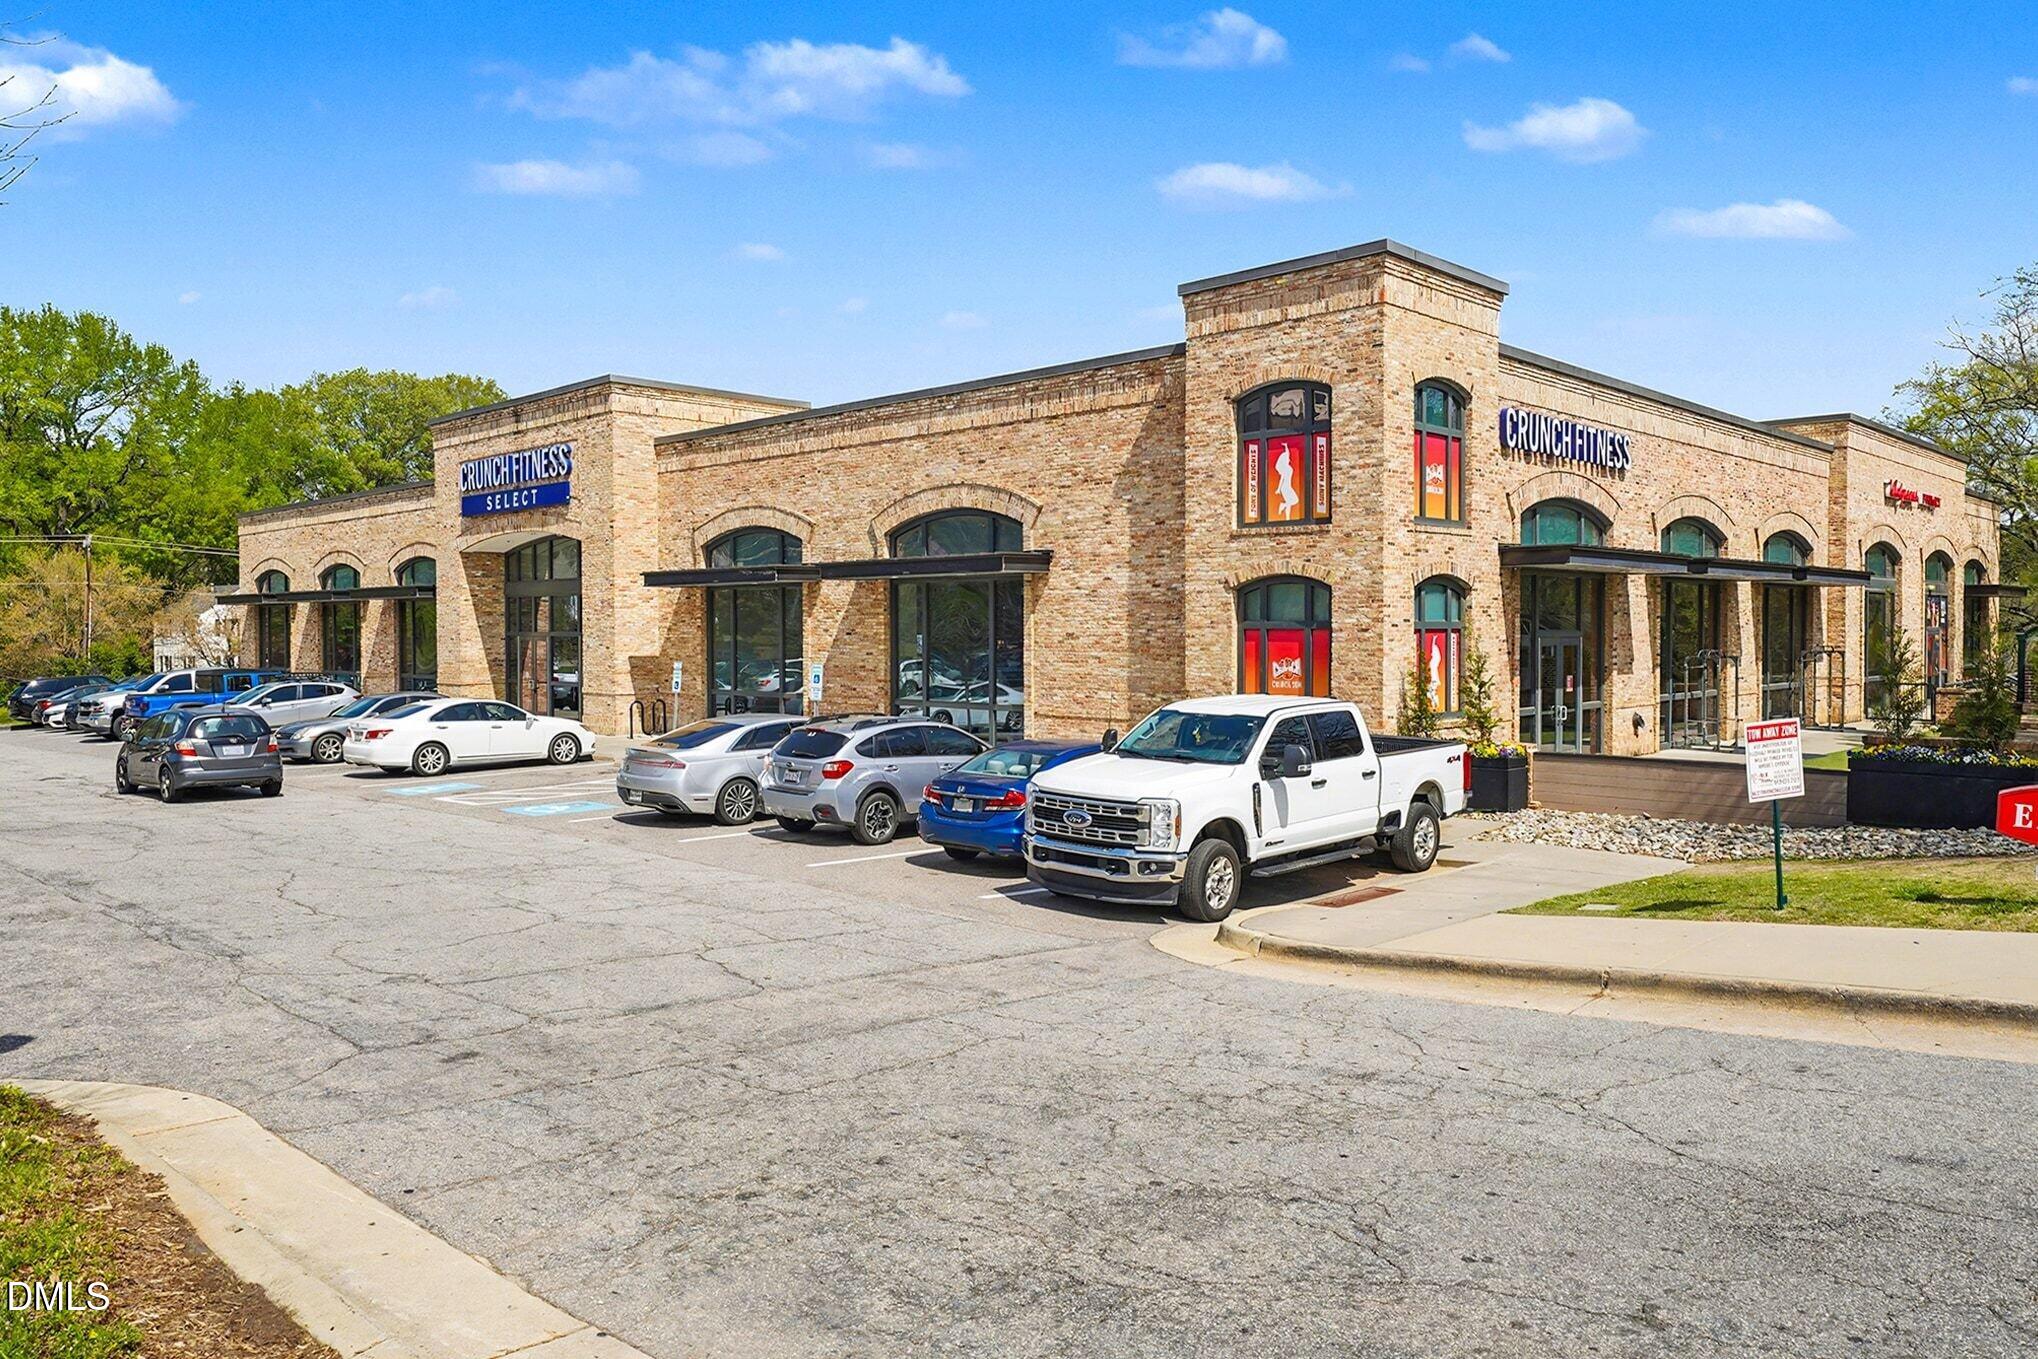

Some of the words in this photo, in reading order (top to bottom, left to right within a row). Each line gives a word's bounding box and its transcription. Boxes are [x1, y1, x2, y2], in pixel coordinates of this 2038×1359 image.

[1503, 407, 1572, 459] CRUNCH
[1575, 424, 1632, 470] FITNESS
[460, 453, 509, 492] CRUNCH
[512, 445, 570, 482] FITNESS
[486, 489, 538, 511] SELECT
[1747, 728, 1761, 741] TOW
[1762, 726, 1779, 738] AWAY
[1781, 724, 1797, 737] ZONE
[2013, 803, 2038, 829] E
